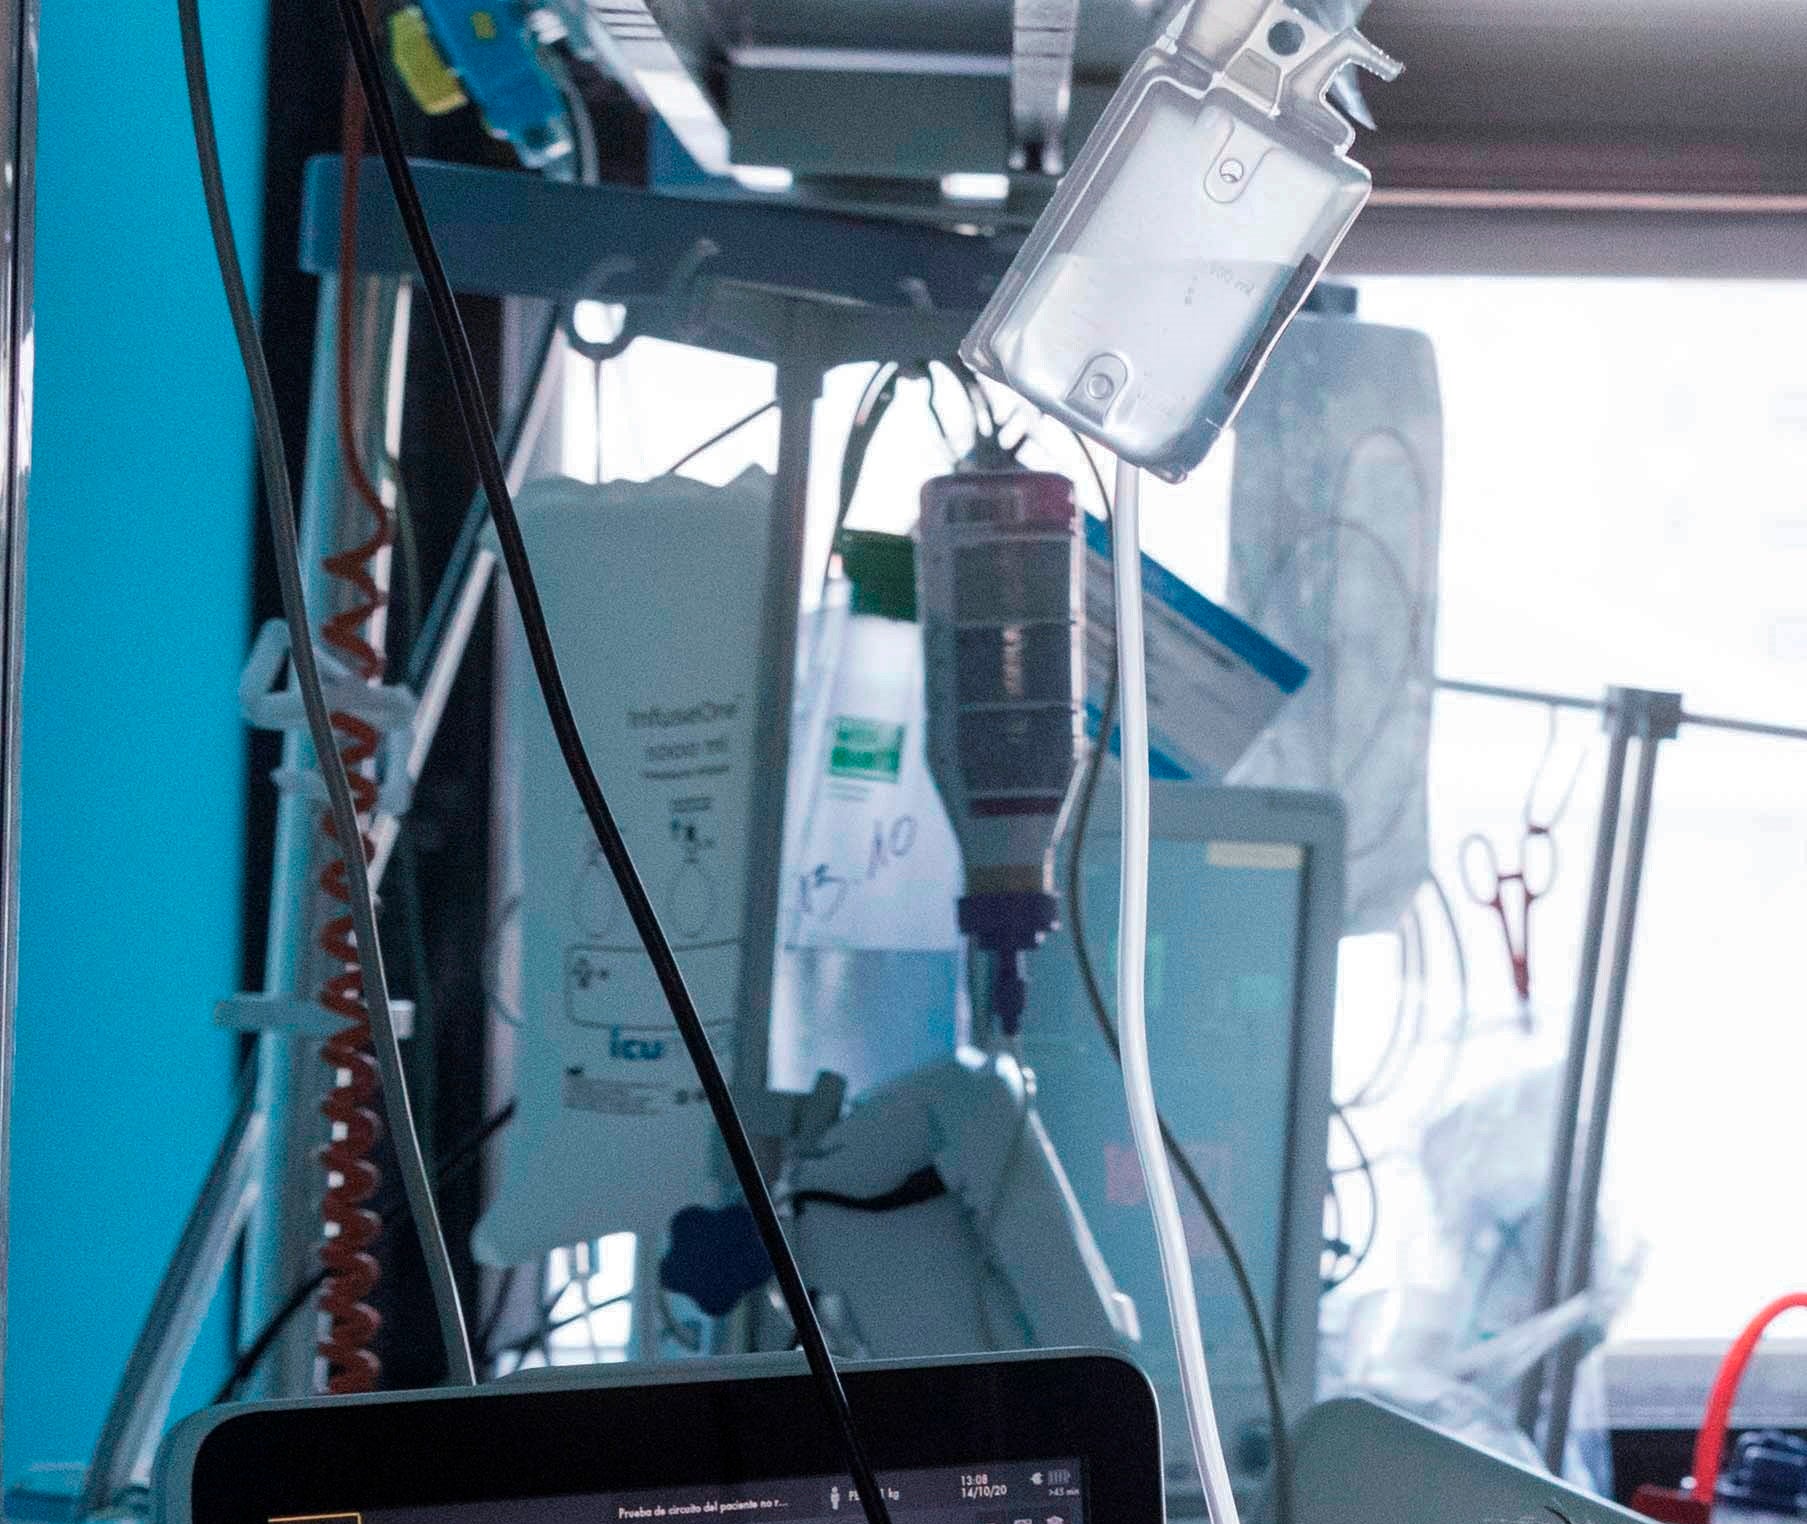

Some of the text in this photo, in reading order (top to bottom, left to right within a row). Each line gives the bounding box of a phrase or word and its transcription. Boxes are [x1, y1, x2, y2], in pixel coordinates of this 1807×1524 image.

[960, 1474, 988, 1485] 13:08
[961, 1484, 1008, 1499] 14/10/20
[618, 1506, 652, 1520] Prueba
[654, 1504, 666, 1517] de
[668, 1502, 702, 1515] circuito
[703, 1500, 718, 1514] del
[719, 1499, 758, 1515] paciente
[760, 1499, 773, 1510] no
